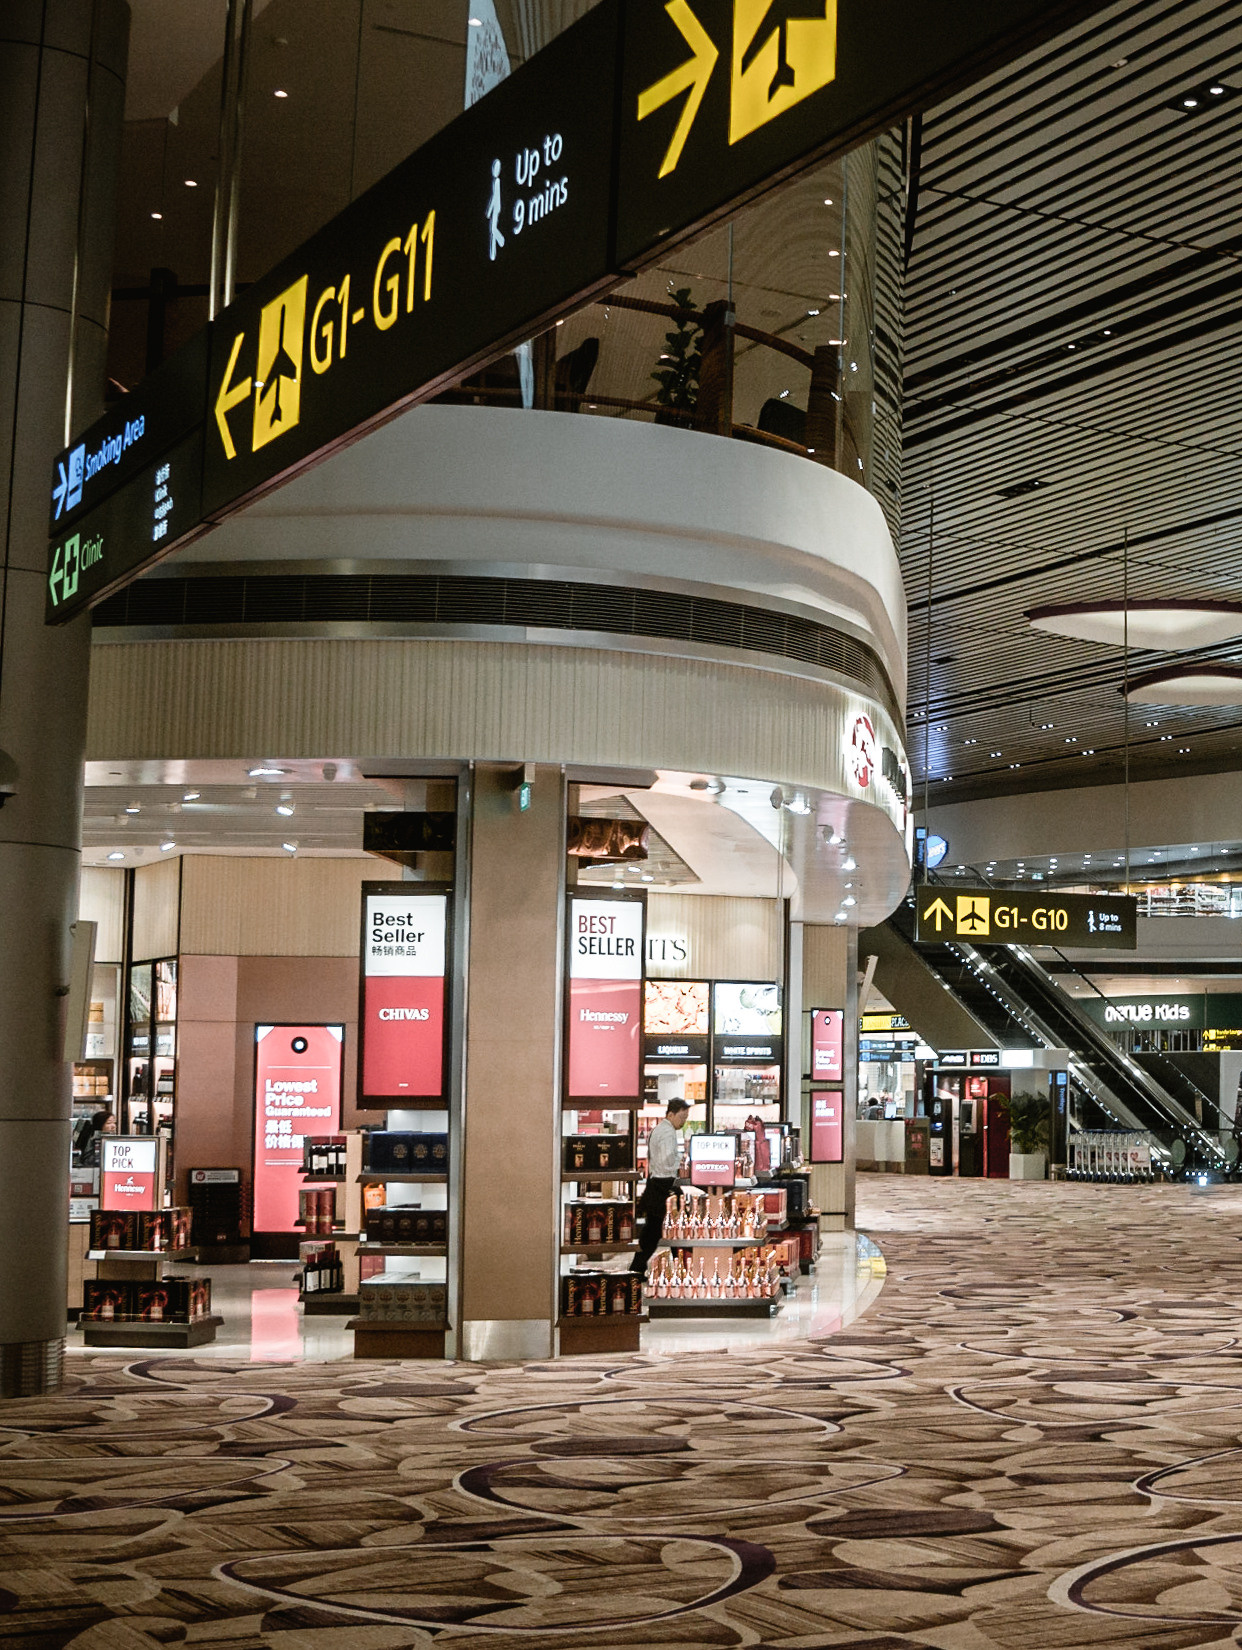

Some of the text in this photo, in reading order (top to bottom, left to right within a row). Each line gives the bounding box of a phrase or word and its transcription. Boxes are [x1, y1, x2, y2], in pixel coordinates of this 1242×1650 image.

[515, 133, 563, 187] Up to
[513, 176, 569, 235] 9 mins
[85, 434, 123, 481] Smoking
[123, 415, 145, 450] Area
[80, 534, 104, 570] Clinic
[373, 912, 414, 927] Best
[578, 915, 617, 934] BEST
[1099, 913, 1109, 922] Up
[1105, 924, 1122, 932] mins
[372, 929, 425, 943] Seller
[371, 945, 417, 956] 畅销商品
[578, 936, 635, 956] SELLER
[645, 939, 687, 960] ITS
[378, 1008, 430, 1021] CHIVAS
[580, 1009, 629, 1024] Hennessy
[980, 1054, 998, 1063] DBS
[265, 1079, 318, 1093] Lowest
[265, 1092, 304, 1106] Price
[265, 1106, 332, 1117] Guaranteed
[264, 1134, 305, 1149] 价格保
[696, 1141, 729, 1150] TOP PICK
[113, 1146, 131, 1156] TOP
[112, 1158, 134, 1169] PICK
